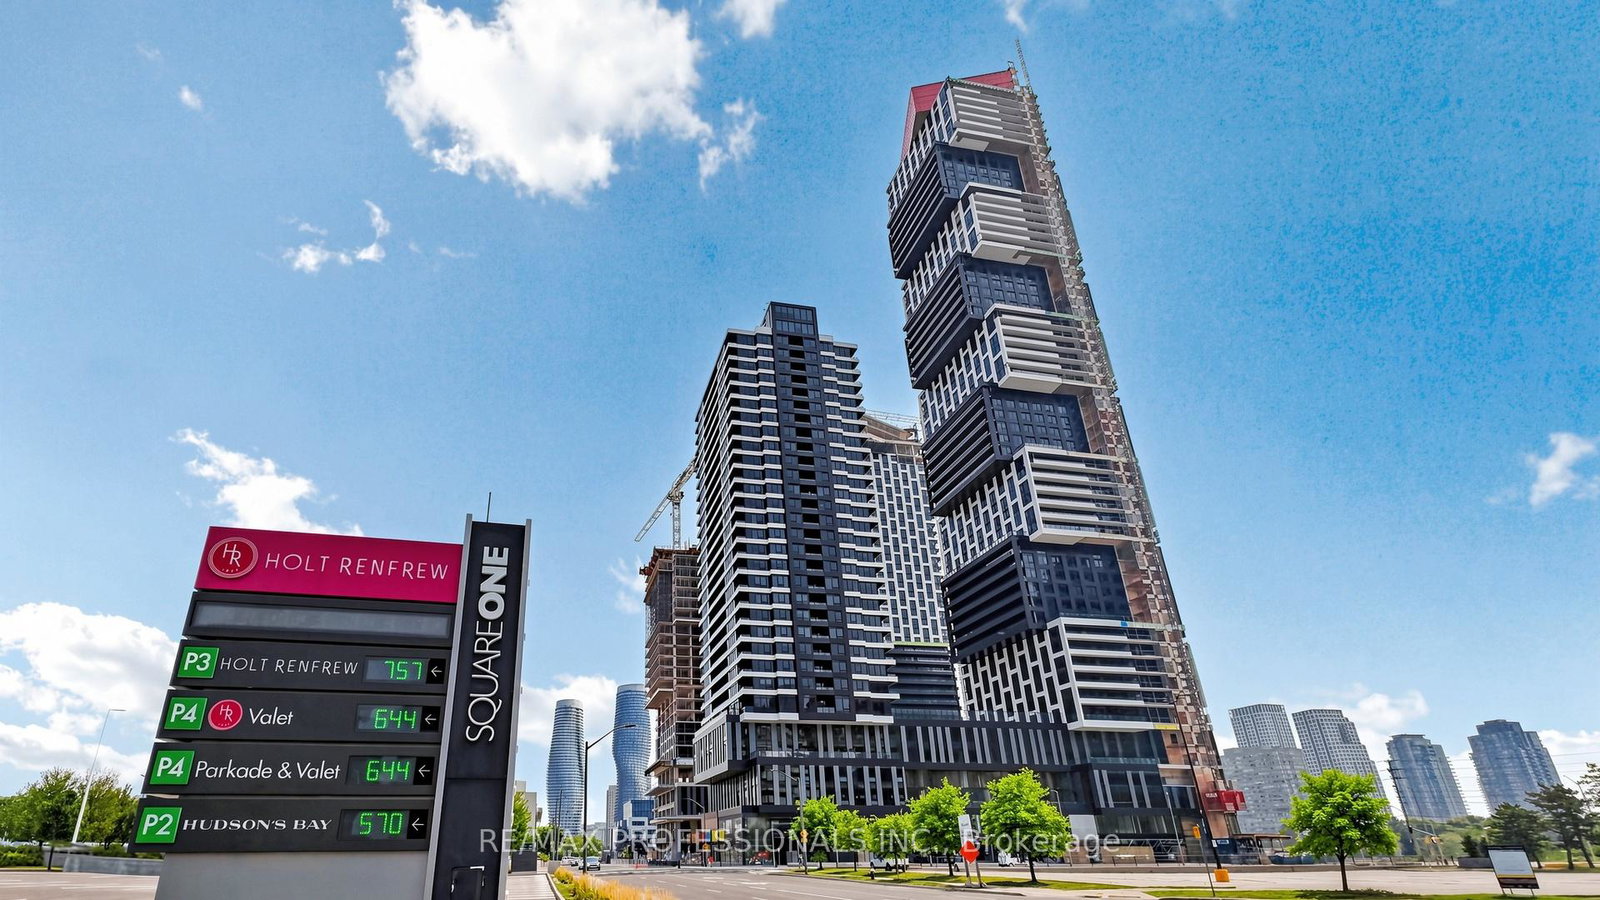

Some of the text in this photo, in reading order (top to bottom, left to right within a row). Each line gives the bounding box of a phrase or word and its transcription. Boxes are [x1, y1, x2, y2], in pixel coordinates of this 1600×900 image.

[264, 552, 448, 580] HOLT RENFREW
[183, 652, 358, 675] P3 HOLT RENFREW
[384, 660, 423, 680] 757
[169, 703, 197, 723] P4
[249, 706, 294, 726] Valet
[373, 708, 417, 730] 644
[156, 756, 341, 780] P4 Parkade & Valet
[366, 760, 411, 782] 644
[142, 813, 332, 836] P2 HUDSON'S BAY
[359, 812, 404, 835] 570
